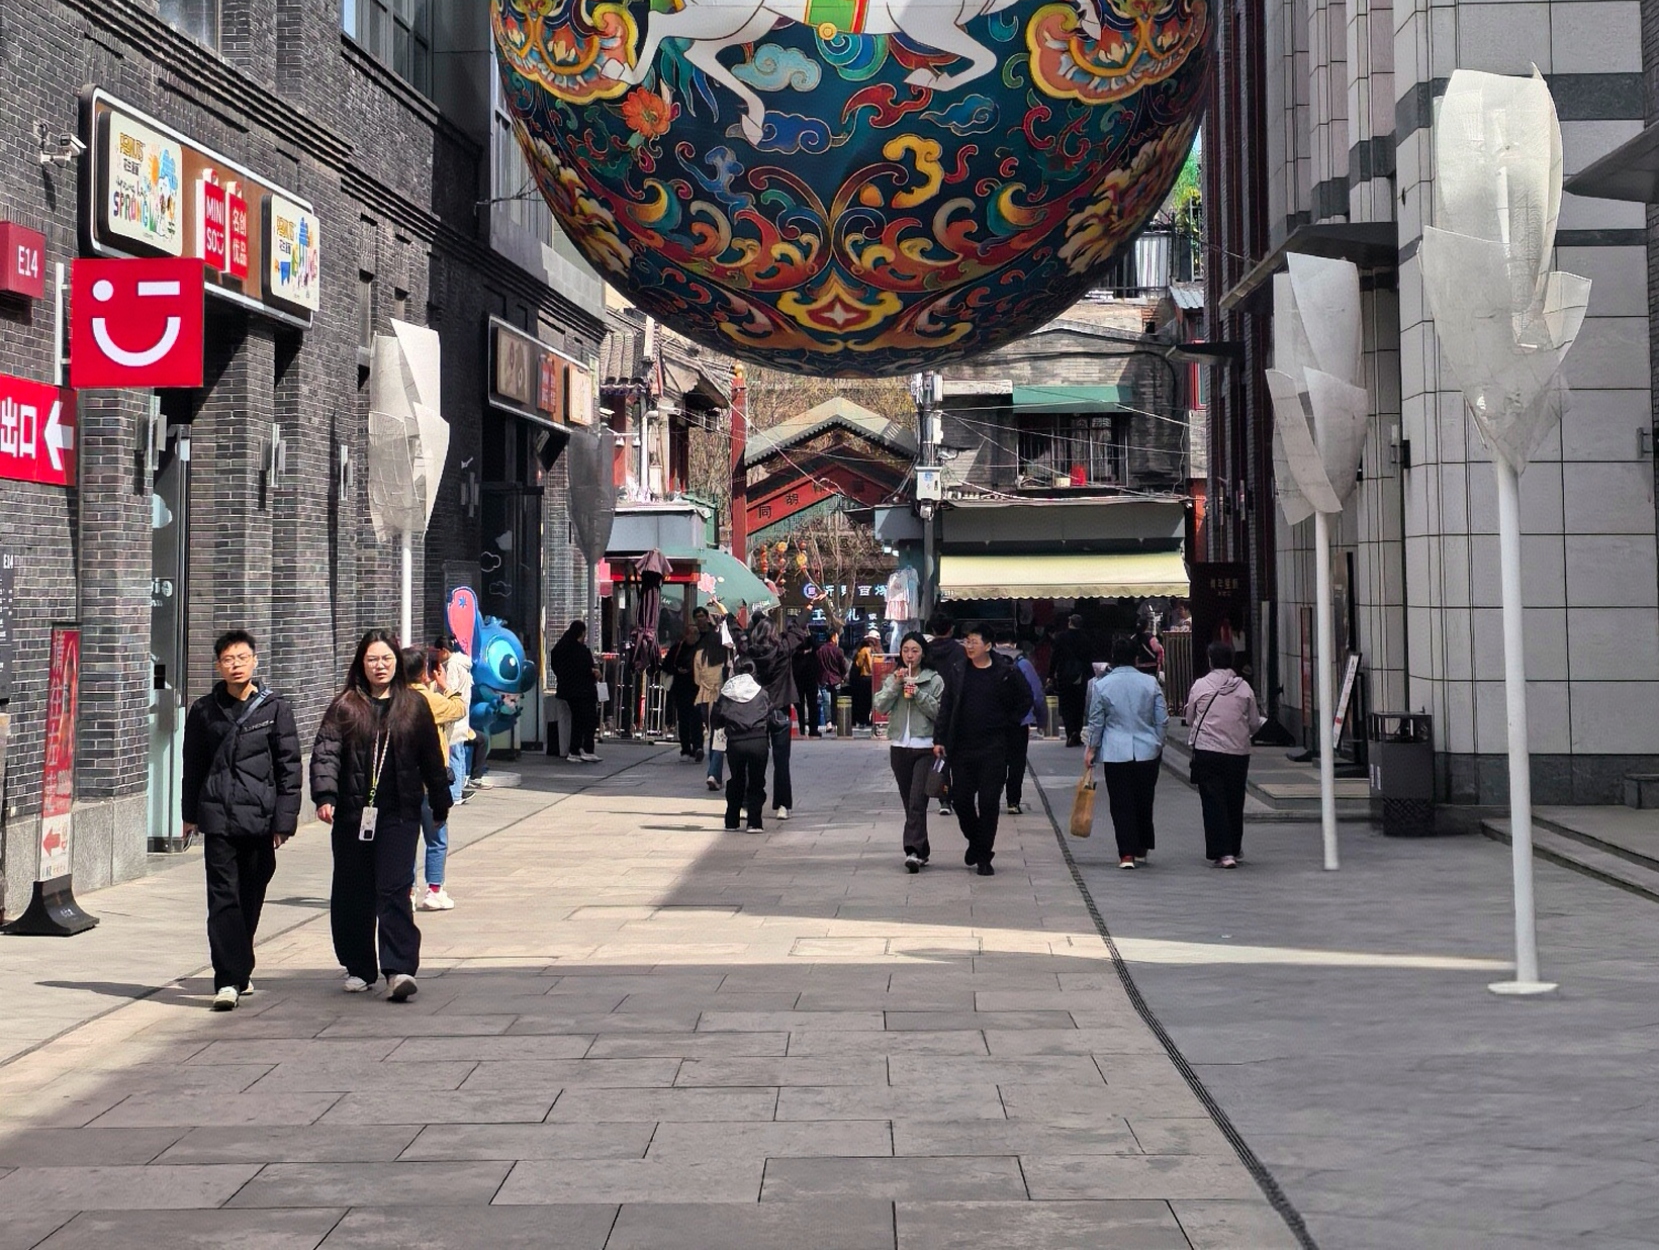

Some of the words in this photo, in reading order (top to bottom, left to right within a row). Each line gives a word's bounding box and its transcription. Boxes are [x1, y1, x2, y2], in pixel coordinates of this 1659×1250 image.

[206, 195, 224, 226] MINI
[232, 206, 247, 237] 名创
[18, 244, 38, 279] E14
[232, 238, 247, 267] 优品
[0, 396, 37, 460] 出口
[3, 554, 13, 569] E14
